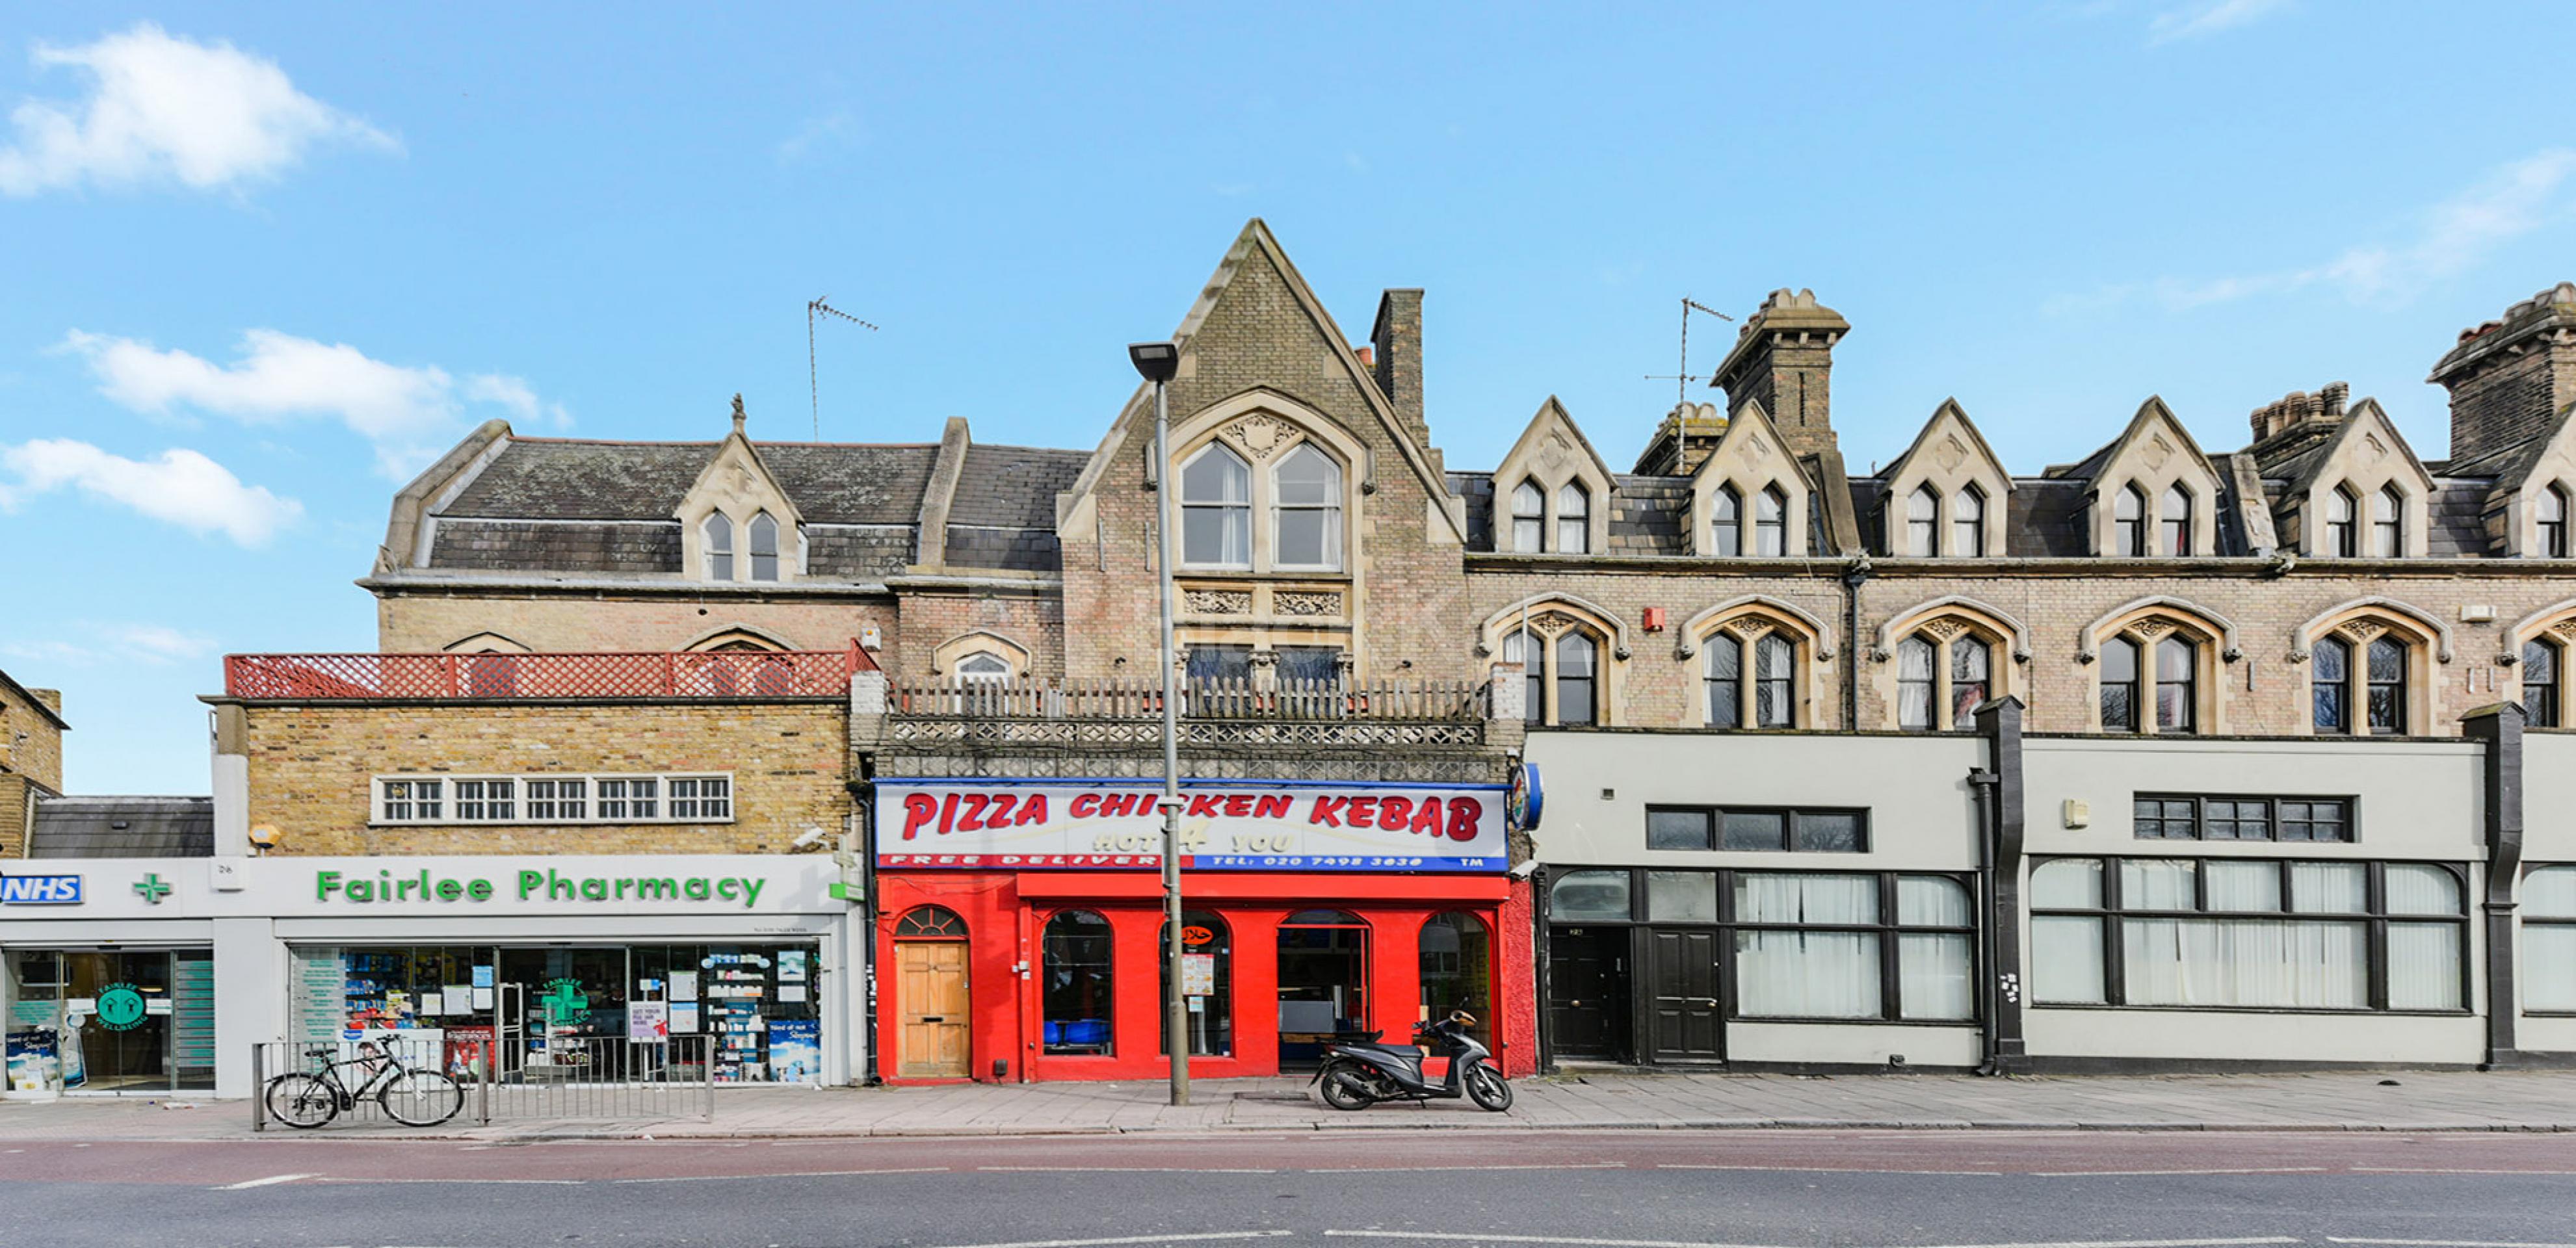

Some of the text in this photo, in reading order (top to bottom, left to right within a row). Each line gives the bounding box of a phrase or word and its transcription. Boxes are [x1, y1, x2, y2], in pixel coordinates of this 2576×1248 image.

[902, 792, 1048, 841] PIZZA
[1309, 794, 1482, 842] KEBAB
[1093, 818, 1294, 853] HOT 4 YOU
[890, 855, 1157, 866] FREE DELIVER
[1263, 857, 1302, 866] 020
[1311, 857, 1363, 866] 7498
[1460, 858, 1484, 866] TM
[3, 878, 77, 900] NHS
[317, 868, 766, 909] Fairlee Pharmacy
[98, 982, 138, 994] FAIRLEE
[96, 1015, 149, 1031] WELLBEING
